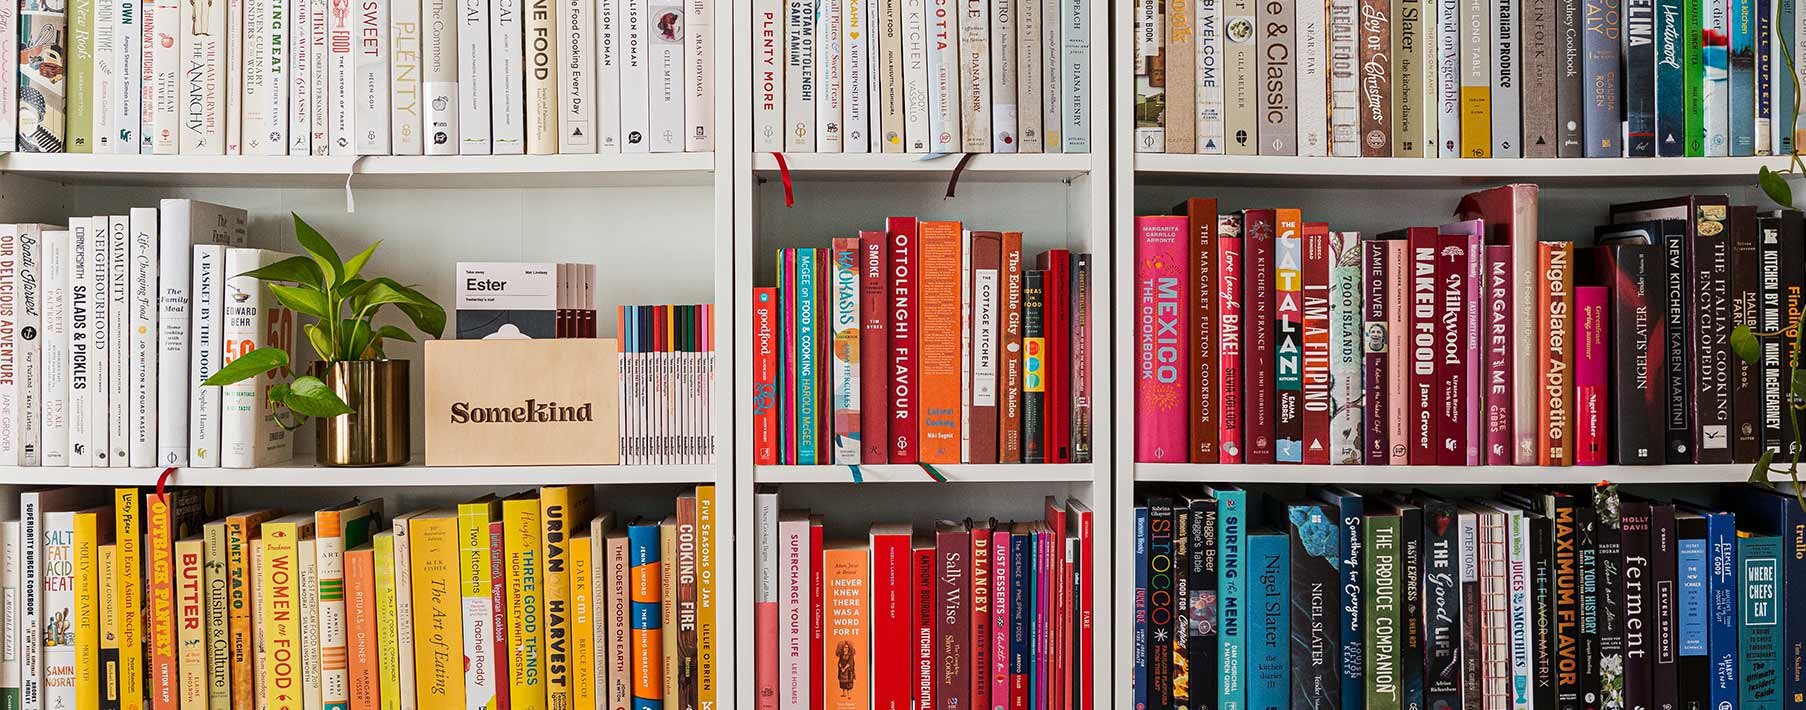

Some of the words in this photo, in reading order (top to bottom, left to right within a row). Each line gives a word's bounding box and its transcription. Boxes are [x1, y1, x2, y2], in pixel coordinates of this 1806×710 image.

[122, 3, 133, 24] OWN
[313, 11, 323, 45] TIKIM
[363, 1, 378, 57] SWEET
[572, 9, 580, 30] Food
[791, 2, 800, 26] SAMI
[802, 2, 812, 35] YOTAM
[1267, 22, 1288, 38] &
[1402, 8, 1418, 52] Slater
[1444, 1, 1455, 33] David
[76, 30, 91, 59] Roots
[194, 42, 202, 58] THE
[332, 31, 350, 53] FOOD
[571, 33, 580, 68] Cooking
[764, 12, 773, 66] PLENTY
[791, 31, 800, 66] TAMIMI
[1445, 36, 1454, 50] on
[1567, 29, 1576, 77] Cookbook
[1659, 4, 1680, 69] Hartwood
[206, 41, 215, 81] WILLIAM
[396, 22, 416, 116] PLENTY
[802, 40, 811, 101] OTTOLENGHI
[571, 71, 581, 95] Every
[764, 72, 773, 110] MORE
[1267, 43, 1288, 124] Classic
[1442, 53, 1456, 113] Vegetables
[1596, 75, 1604, 106] RODEN
[340, 101, 344, 109] OF
[572, 98, 581, 114] Day
[1402, 105, 1410, 132] diaries
[1, 235, 13, 256] OUR
[202, 251, 210, 260] A
[869, 244, 879, 278] SMOKE
[1009, 251, 1018, 272] The
[1669, 239, 1680, 268] NEW
[1714, 241, 1725, 273] THE
[114, 223, 124, 304] COMMUNITY
[801, 256, 809, 285] McGEE
[1546, 251, 1566, 296] Nigel
[1, 260, 13, 316] DELICIOUS
[95, 229, 105, 350] NEIGHBOURHOOD
[201, 262, 210, 306] BASKET
[466, 278, 507, 292] Ester
[801, 287, 809, 298] on
[896, 234, 908, 339] OTTOLENGHI
[1009, 274, 1019, 310] Edible
[1143, 279, 1153, 304] THE
[1342, 276, 1352, 308] 7000
[1415, 247, 1434, 318] NAKED
[1670, 272, 1681, 325] KITCHEN
[73, 285, 86, 328] SALADS
[201, 308, 209, 322] BY
[226, 307, 257, 316] EDWARD
[802, 300, 810, 324] FOOD
[982, 285, 990, 325] COTTAGE
[1258, 301, 1265, 312] IN
[1715, 280, 1725, 345] ITALIAN
[73, 332, 85, 341] &
[200, 324, 209, 347] THE
[1007, 312, 1019, 334] City
[1157, 277, 1177, 384] MEXICO
[1257, 315, 1265, 351] FRANCE
[1343, 310, 1352, 363] ISLANDS
[1550, 301, 1566, 354] Slater
[1700, 270, 1712, 393] ENCYCLOPEDIA
[1, 320, 14, 385] ADVENTURE
[802, 336, 811, 376] COOKING
[981, 329, 990, 367] KITCHEN
[1143, 306, 1152, 380] COOKBOOK
[1415, 323, 1434, 375] FOOD
[74, 344, 86, 389] PICKLES
[896, 347, 908, 419] FLAVOUR
[802, 379, 811, 414] HAROLD
[1420, 384, 1430, 408] Jane
[1547, 359, 1566, 439] Appetite
[1716, 350, 1727, 421] COOKING
[450, 398, 593, 424] Somekind
[802, 416, 811, 446] McGEE
[1421, 411, 1430, 448] Grover
[45, 530, 74, 545] SALT
[48, 546, 69, 561] FAT
[124, 539, 133, 553] 101
[547, 505, 564, 572] URBAN
[680, 524, 693, 584] COOKING
[1376, 527, 1393, 549] THE
[1465, 526, 1473, 551] AFTER
[46, 560, 72, 576] ACID
[123, 556, 134, 577] Easy
[791, 534, 799, 604] SUPERCHARGE
[941, 552, 961, 586] Sally
[997, 544, 1005, 566] JUST
[1465, 553, 1474, 579] TOAST
[1556, 507, 1574, 605] MAXIMUM
[44, 577, 74, 591] HEAT
[271, 556, 289, 621] WOMEN
[975, 539, 987, 613] DELANCEY
[1376, 556, 1393, 611] PRODUCE
[1748, 566, 1773, 581] WHERE
[125, 581, 135, 606] Asian
[183, 553, 199, 630] BUTTER
[431, 579, 446, 603] The
[947, 588, 960, 624] Wise
[997, 569, 1005, 613] DESSERTS
[1312, 583, 1322, 620] NIGEL
[1626, 556, 1647, 659] ferment
[1749, 584, 1773, 599] CHEFS
[432, 607, 446, 629] Art
[681, 602, 694, 631] FIRE
[791, 608, 799, 634] YOUR
[1754, 602, 1768, 617] EAT
[124, 612, 136, 648] Recipes
[430, 634, 448, 648] of
[474, 620, 484, 653] Rachel
[549, 600, 566, 687] HARVEST
[1311, 622, 1322, 666] SLATER
[274, 639, 292, 689] FOOD
[791, 638, 799, 657] LIFE
[1376, 617, 1396, 702] COMPANION
[1559, 610, 1576, 686] FLAVOR
[431, 651, 448, 695] Eating
[475, 656, 485, 687] Roddy
